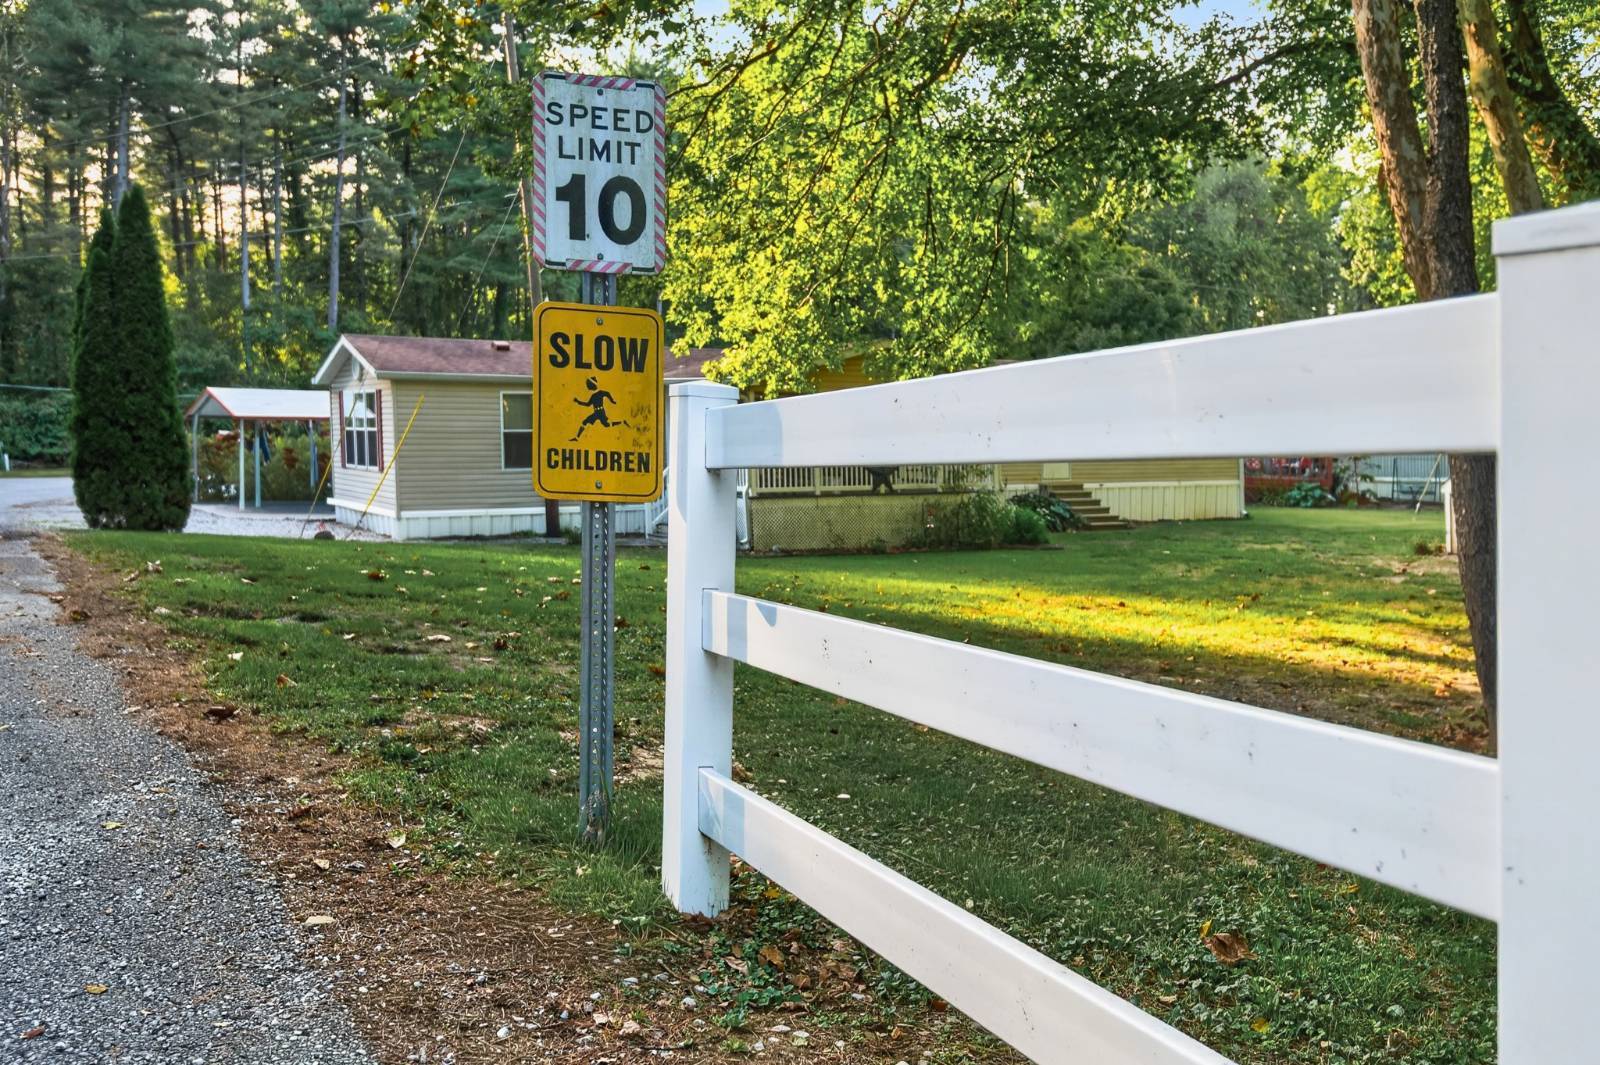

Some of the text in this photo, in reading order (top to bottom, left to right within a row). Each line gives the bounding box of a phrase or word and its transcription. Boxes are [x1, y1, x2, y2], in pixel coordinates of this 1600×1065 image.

[545, 102, 654, 134] SPEED
[558, 135, 641, 165] LIMIT
[555, 173, 647, 246] 10
[549, 331, 649, 373] SLOW
[546, 447, 651, 474] CHILDREN
